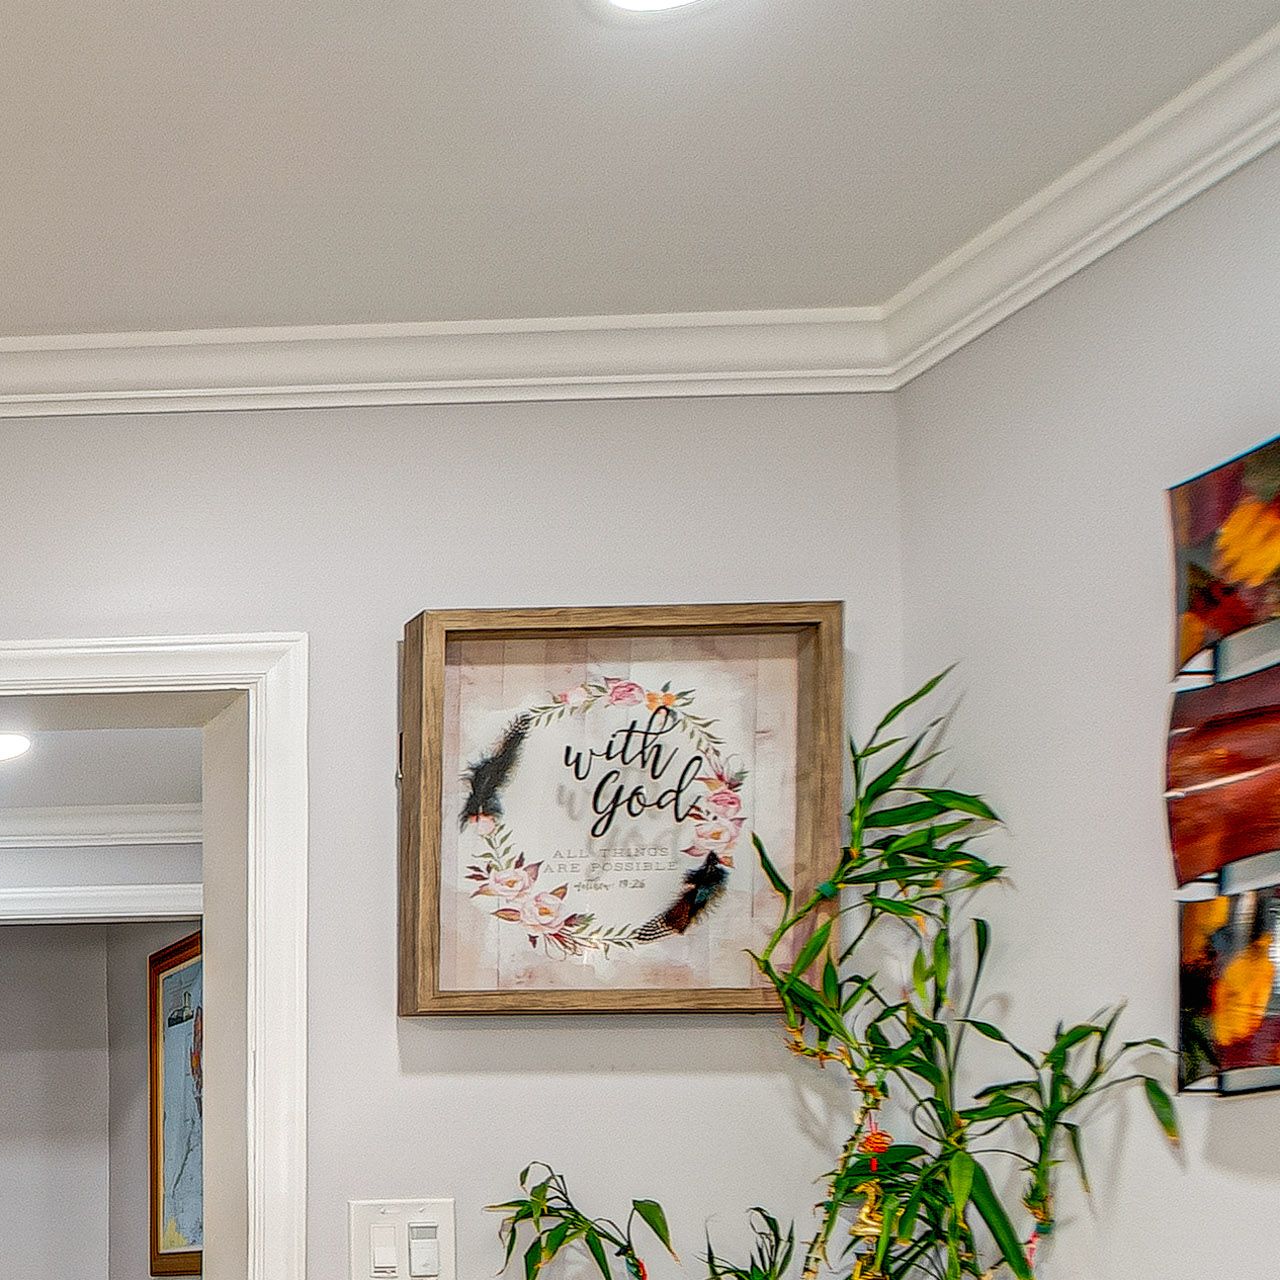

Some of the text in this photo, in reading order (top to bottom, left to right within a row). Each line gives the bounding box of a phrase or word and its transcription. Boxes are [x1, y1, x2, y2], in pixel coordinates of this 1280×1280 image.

[564, 706, 682, 780] with
[552, 847, 670, 859] ALL THINGS
[543, 861, 679, 873] ARE POSSIBLE
